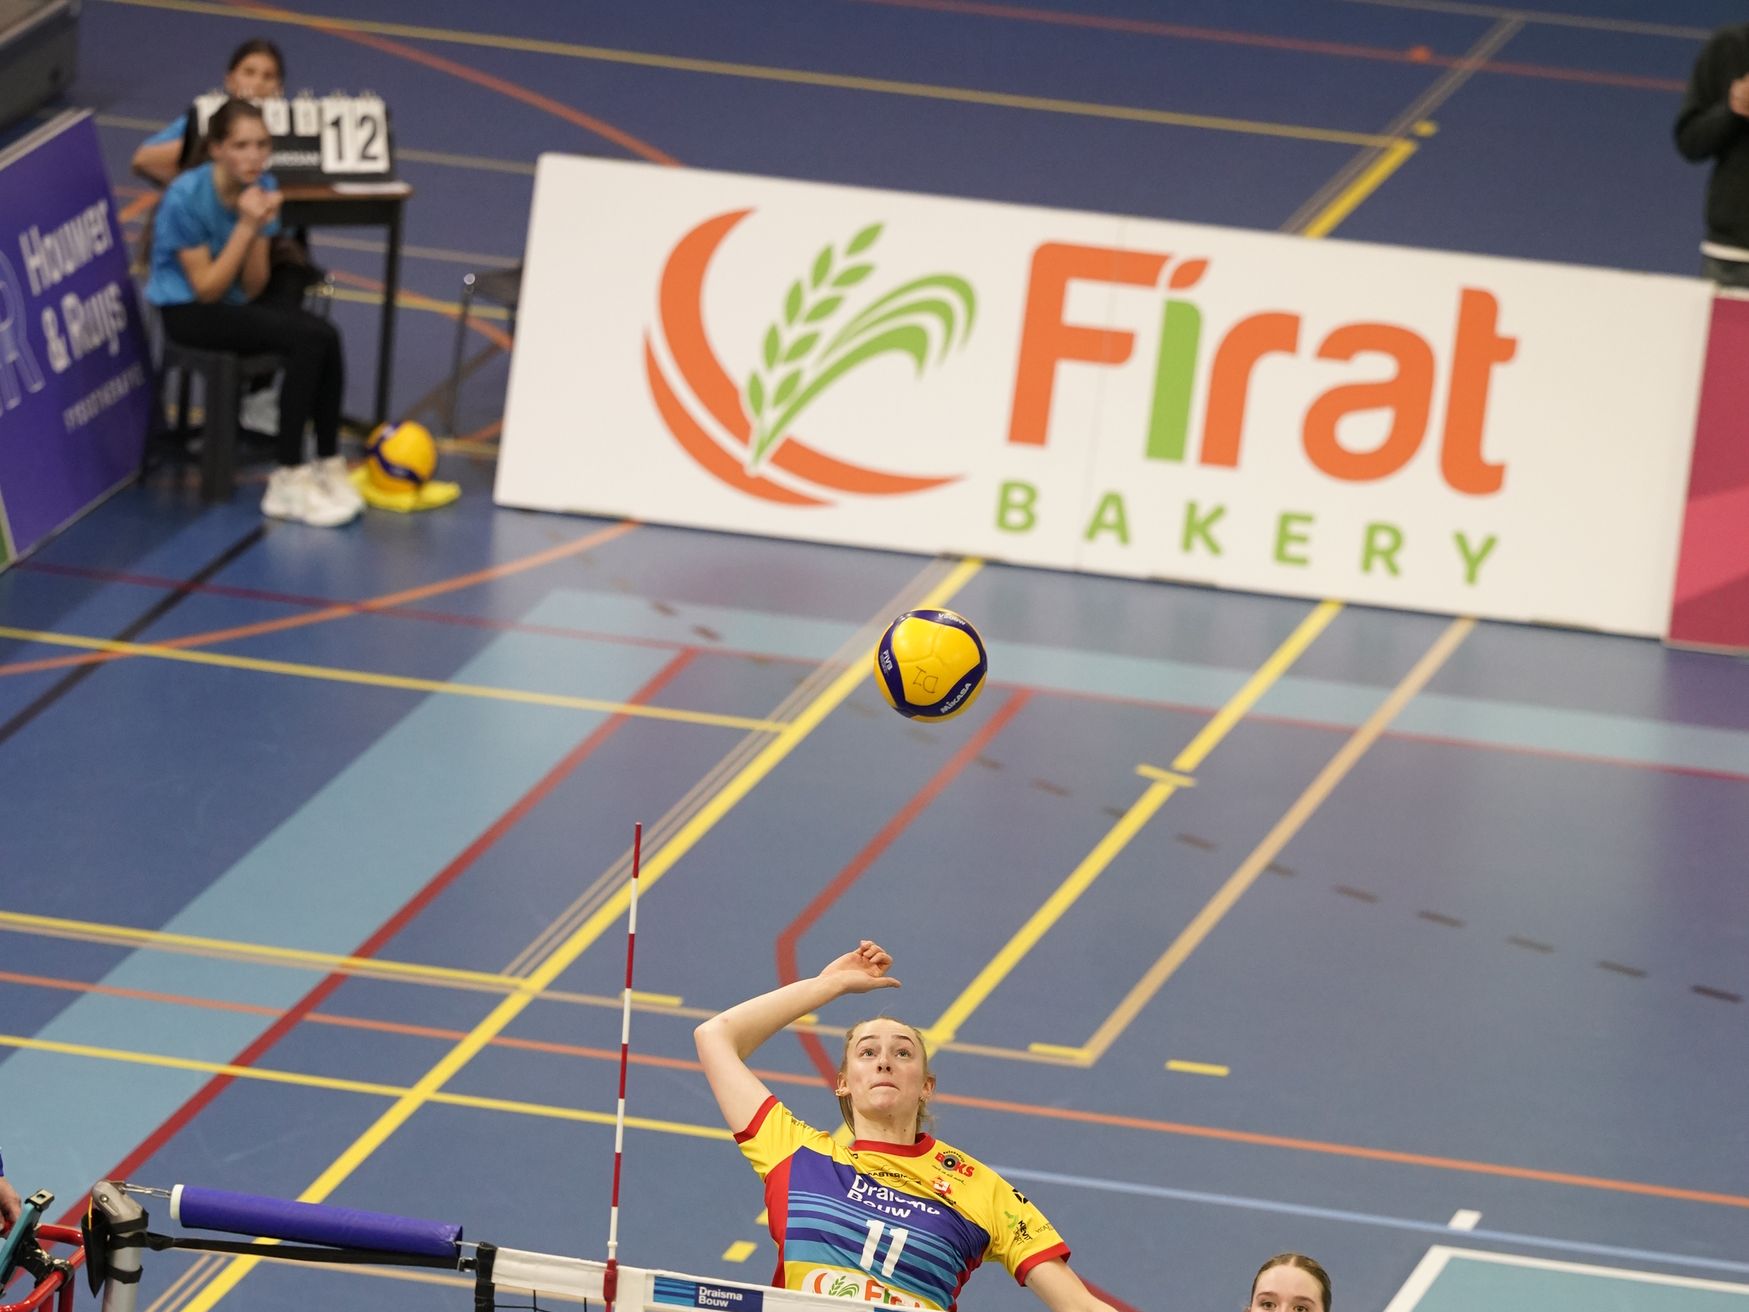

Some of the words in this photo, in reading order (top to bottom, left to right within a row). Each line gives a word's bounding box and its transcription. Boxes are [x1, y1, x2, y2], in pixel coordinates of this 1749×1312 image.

[328, 113, 379, 162] 12
[19, 198, 113, 297] Houwer
[41, 306, 72, 374] &
[61, 282, 127, 361] Ruys
[1007, 241, 1518, 498] Firat
[995, 480, 1498, 586] BAKERY
[860, 1219, 909, 1278] 11
[698, 1286, 743, 1301] Draisma
[698, 1295, 729, 1308] Bouw
